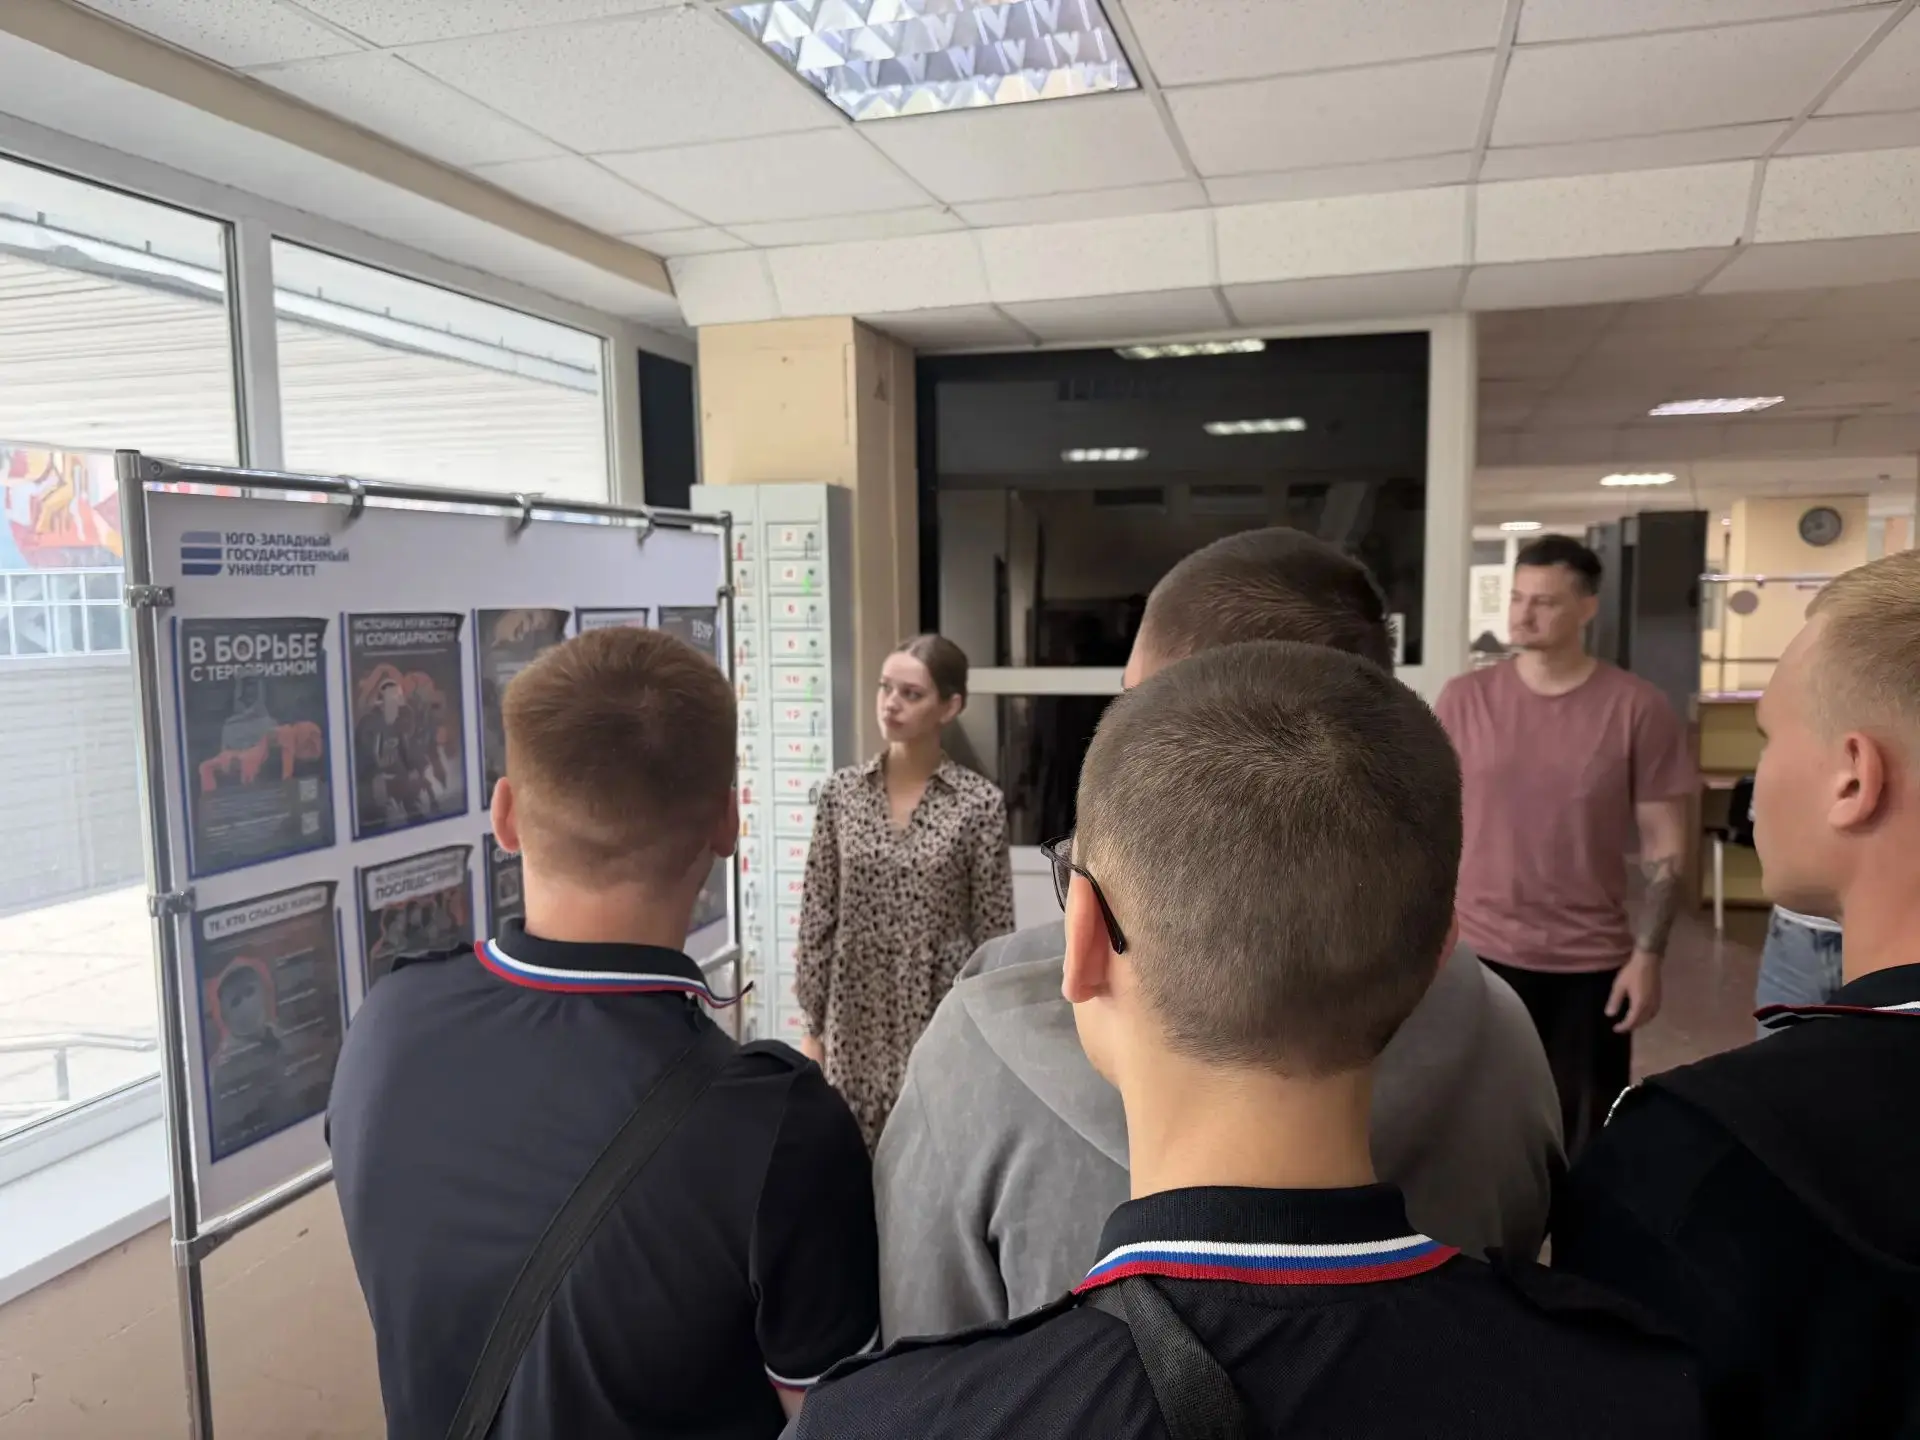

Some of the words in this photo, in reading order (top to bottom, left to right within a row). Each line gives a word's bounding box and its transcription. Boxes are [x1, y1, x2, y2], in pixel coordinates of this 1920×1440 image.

[226, 532, 331, 547] ЮГО-ЗАПАДНЫЙ
[226, 548, 349, 562] ГОСУДАРСТВЕННЫЙ
[227, 563, 317, 576] УНИВЕРСИТЕТ
[189, 636, 207, 664] В
[214, 632, 319, 663] БОРЬБЕ
[190, 666, 203, 682] С
[206, 660, 318, 681] ТЕРРОРИЗМОМ
